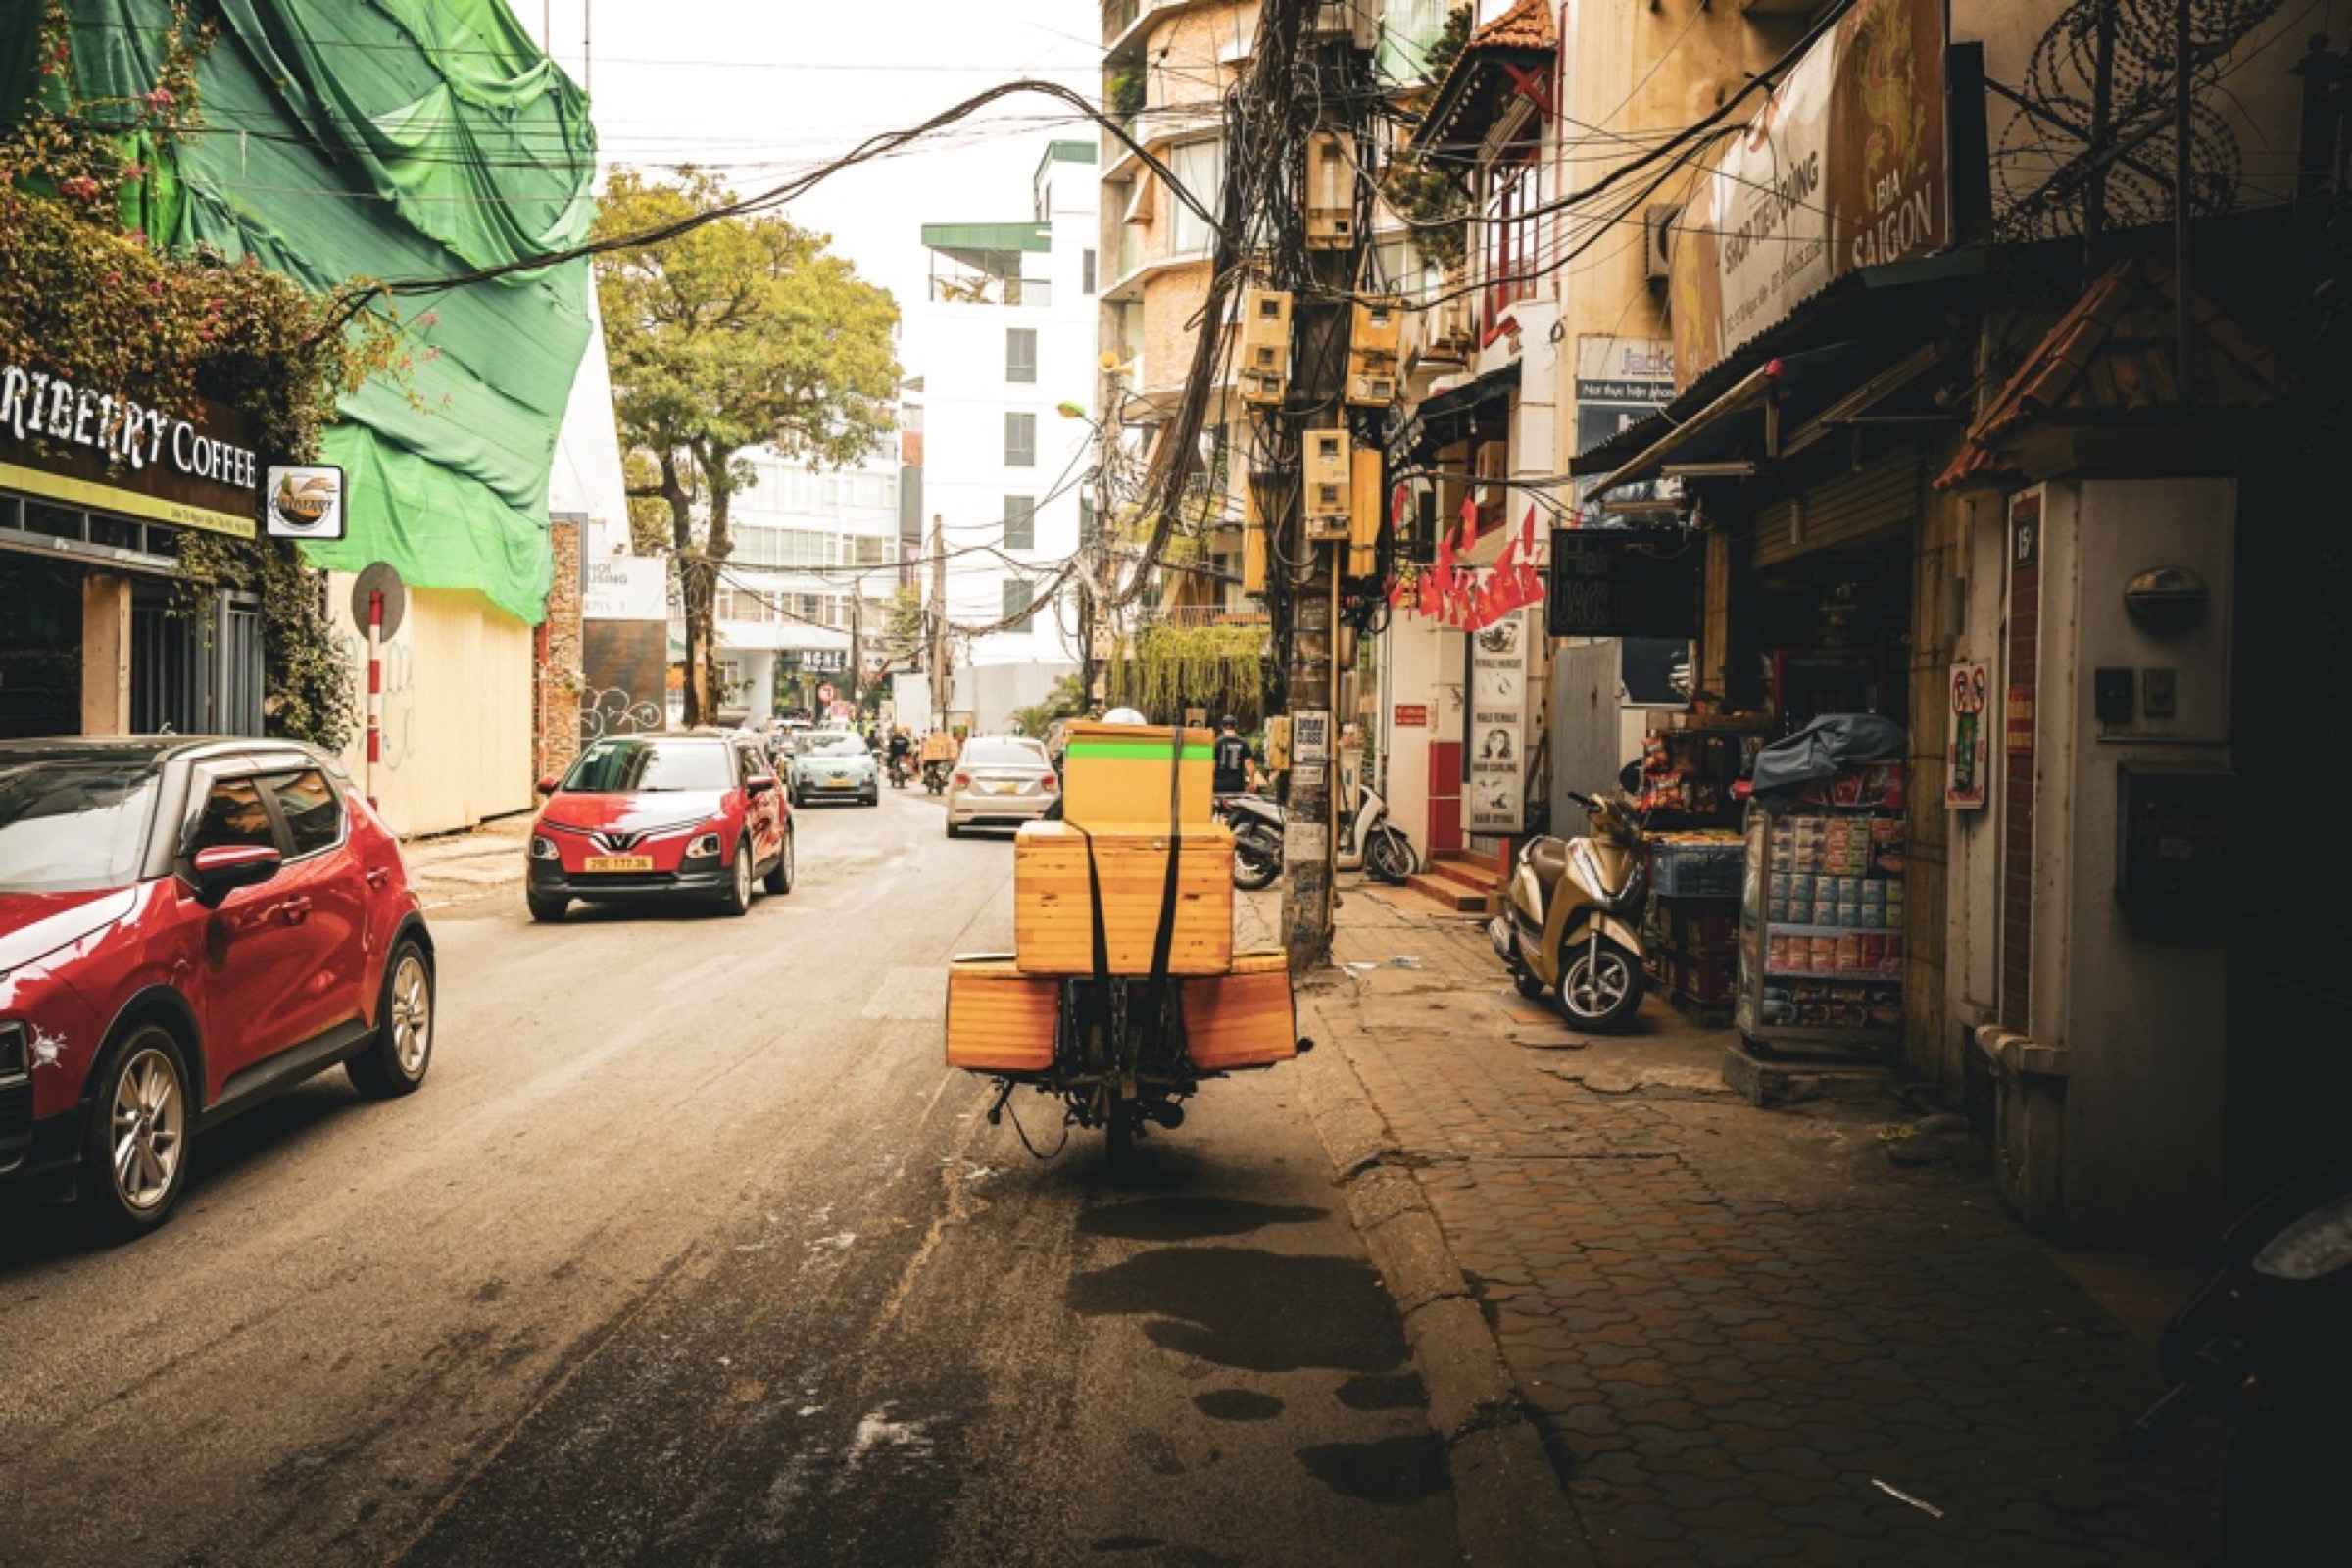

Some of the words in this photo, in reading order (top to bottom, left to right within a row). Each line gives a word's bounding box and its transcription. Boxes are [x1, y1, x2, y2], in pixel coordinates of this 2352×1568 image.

[1852, 180, 1932, 268] SAIGON
[1876, 169, 1901, 214] BIA
[172, 421, 256, 489] COFFEE
